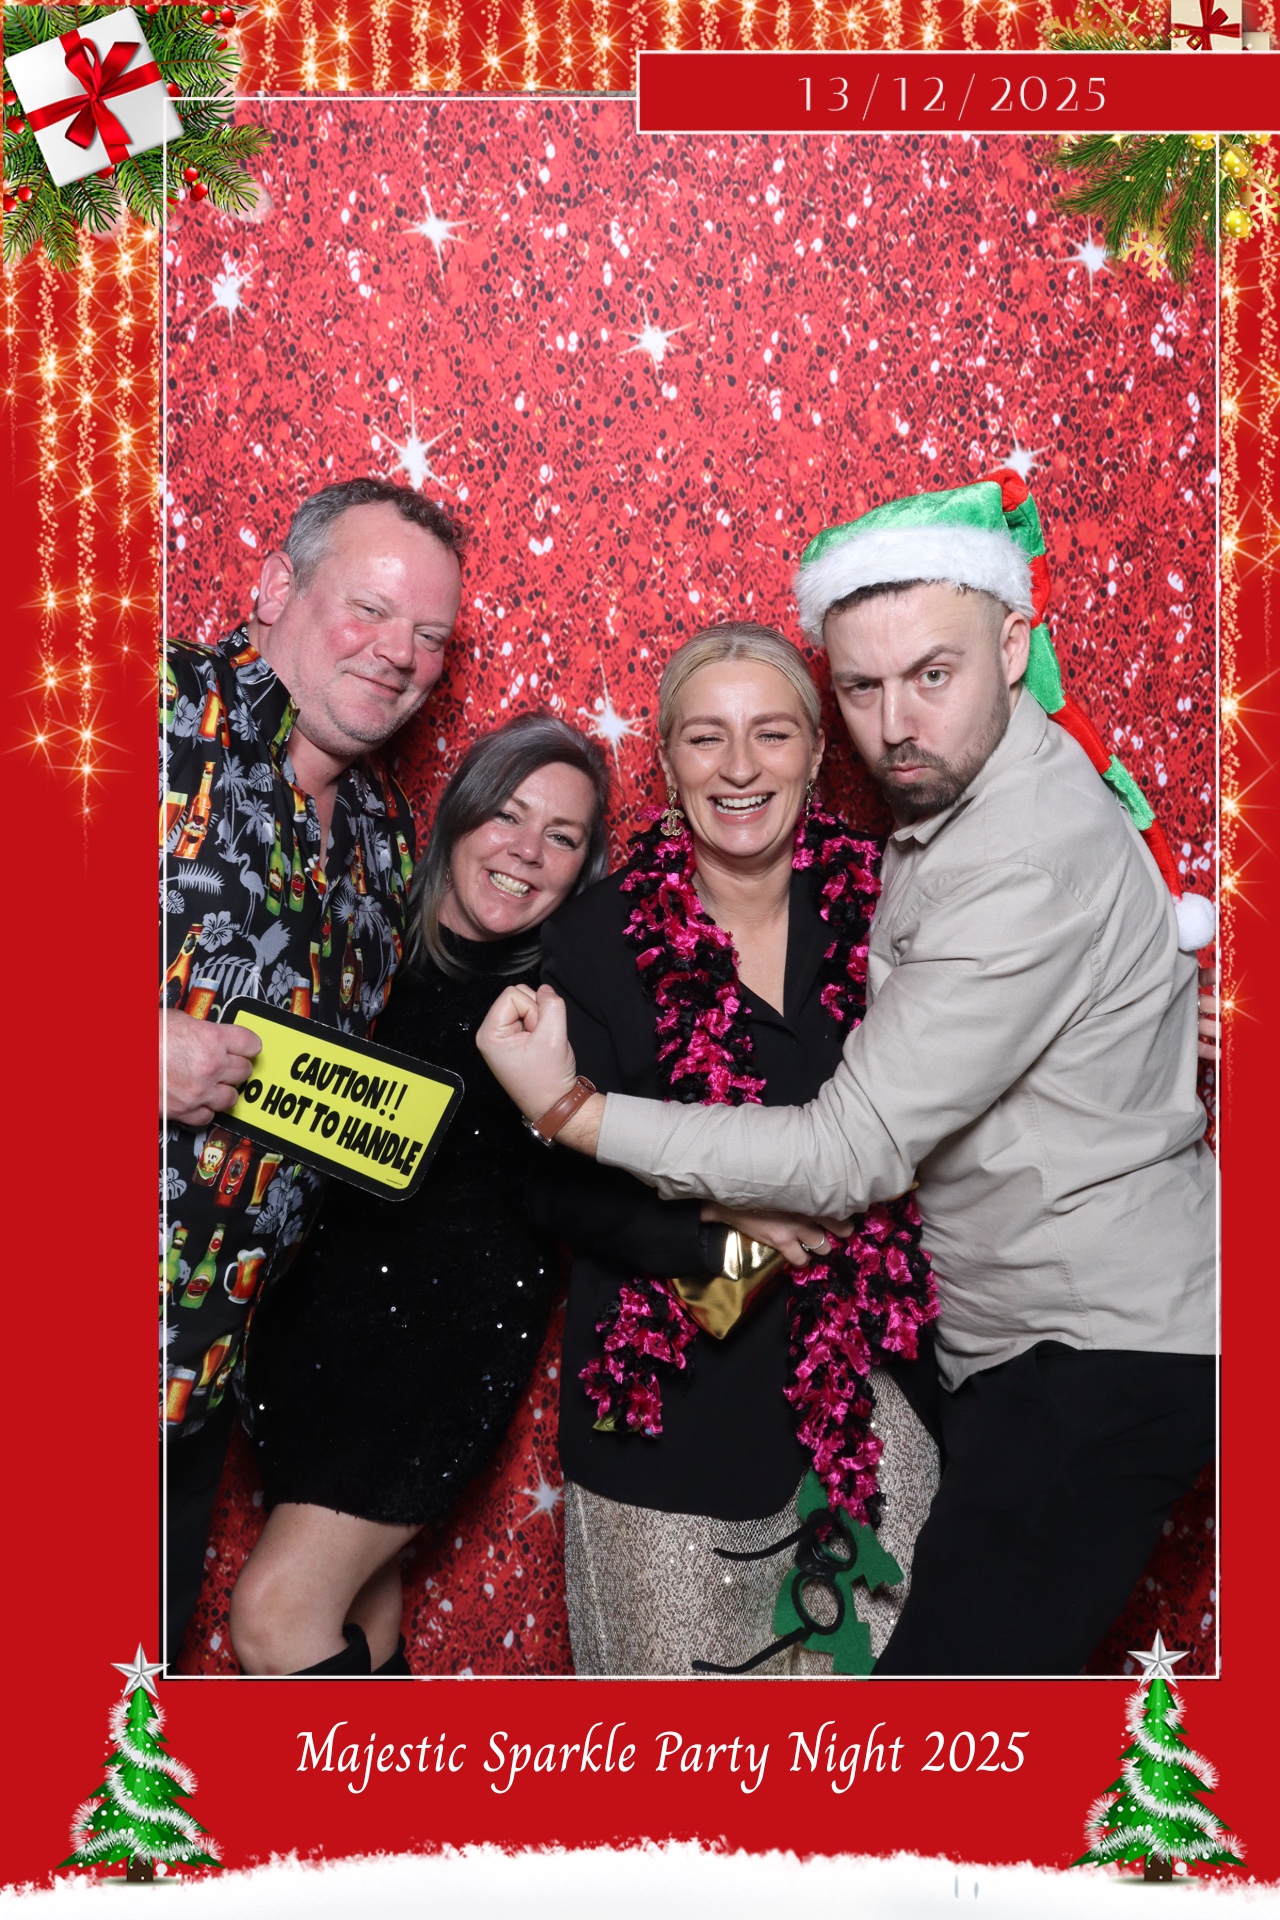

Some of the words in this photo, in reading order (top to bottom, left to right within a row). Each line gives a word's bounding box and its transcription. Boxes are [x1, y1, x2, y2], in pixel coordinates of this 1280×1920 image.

[290, 1053, 408, 1121] CAUTION!!
[261, 1084, 313, 1125] HOT
[310, 1103, 340, 1138] TO
[336, 1115, 424, 1176] HANDLE
